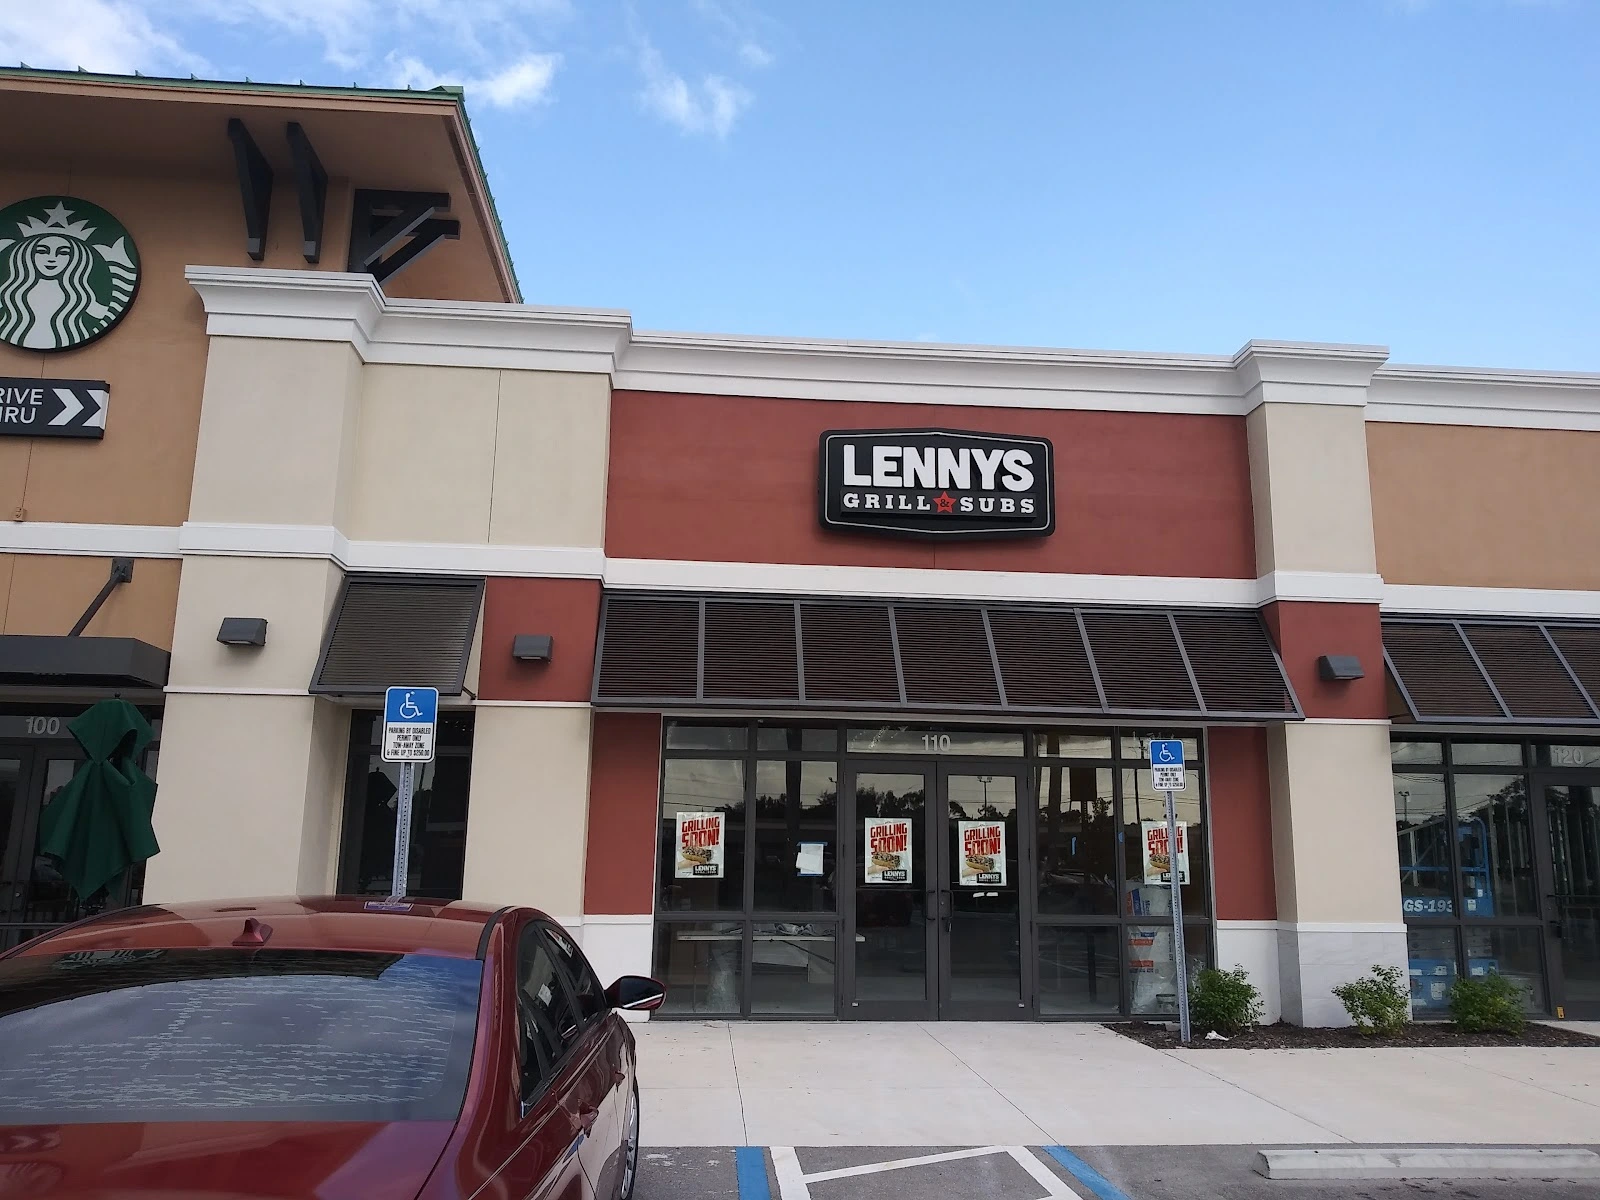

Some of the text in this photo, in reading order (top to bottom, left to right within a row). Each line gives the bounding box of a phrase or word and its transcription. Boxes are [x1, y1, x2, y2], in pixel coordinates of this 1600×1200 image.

[843, 444, 1035, 492] LENNYS
[843, 492, 931, 511] GRILL
[959, 497, 1035, 513] SUBS
[26, 716, 60, 735] 100
[921, 734, 951, 751] 110
[1553, 747, 1584, 765] 120
[681, 816, 720, 833] GRILLING
[870, 822, 908, 838] GRILLING
[963, 826, 1001, 841] GRILLING
[1147, 825, 1183, 841] GRILLG
[681, 829, 720, 850] SOON!
[870, 834, 908, 856] SOON!
[964, 838, 1001, 858] SOON!
